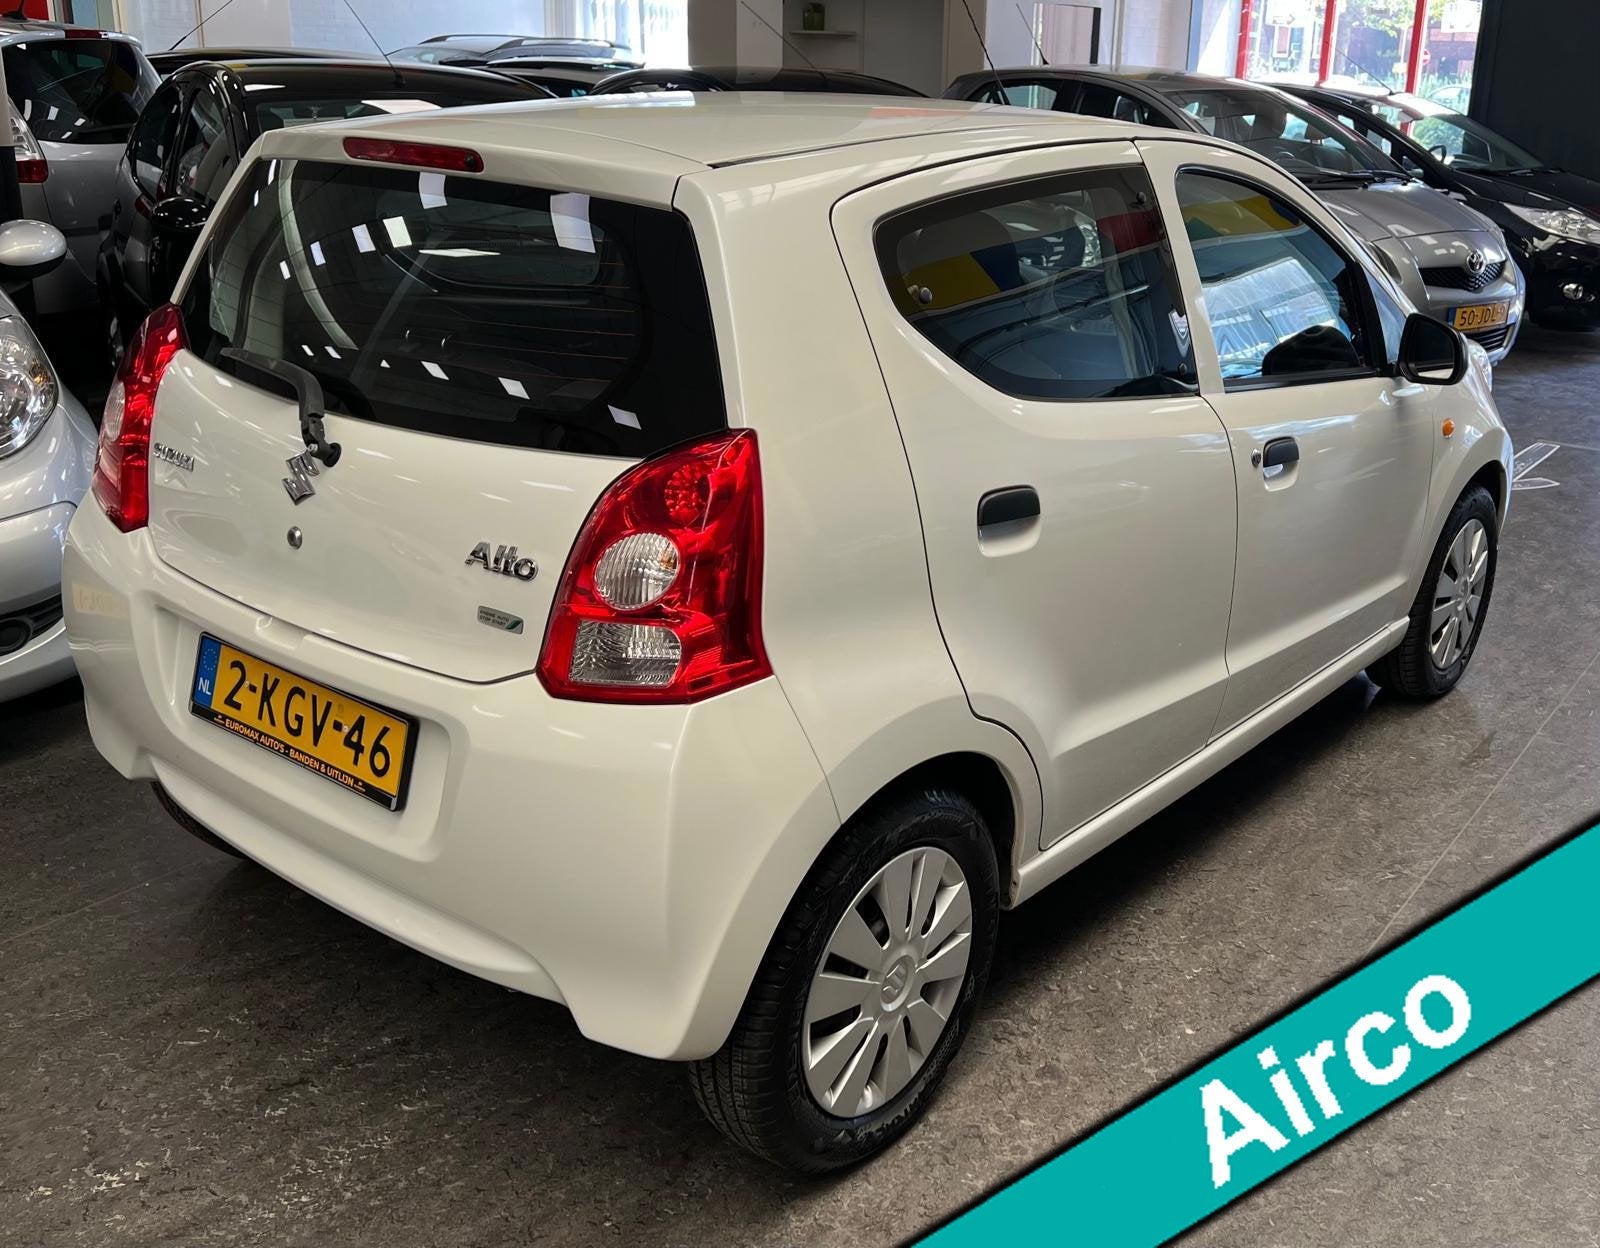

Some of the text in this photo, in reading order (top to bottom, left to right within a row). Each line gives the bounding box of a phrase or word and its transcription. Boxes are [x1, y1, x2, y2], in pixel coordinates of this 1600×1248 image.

[153, 442, 195, 472] SUZUKI
[464, 541, 539, 582] Alto
[198, 677, 212, 695] NL
[224, 660, 391, 778] 2-KGV-46
[225, 718, 260, 741] EUROMAX
[260, 735, 285, 753] AUTO'S
[289, 748, 320, 770] BANDEN
[320, 763, 326, 773] &
[327, 766, 354, 786] UITLIJN
